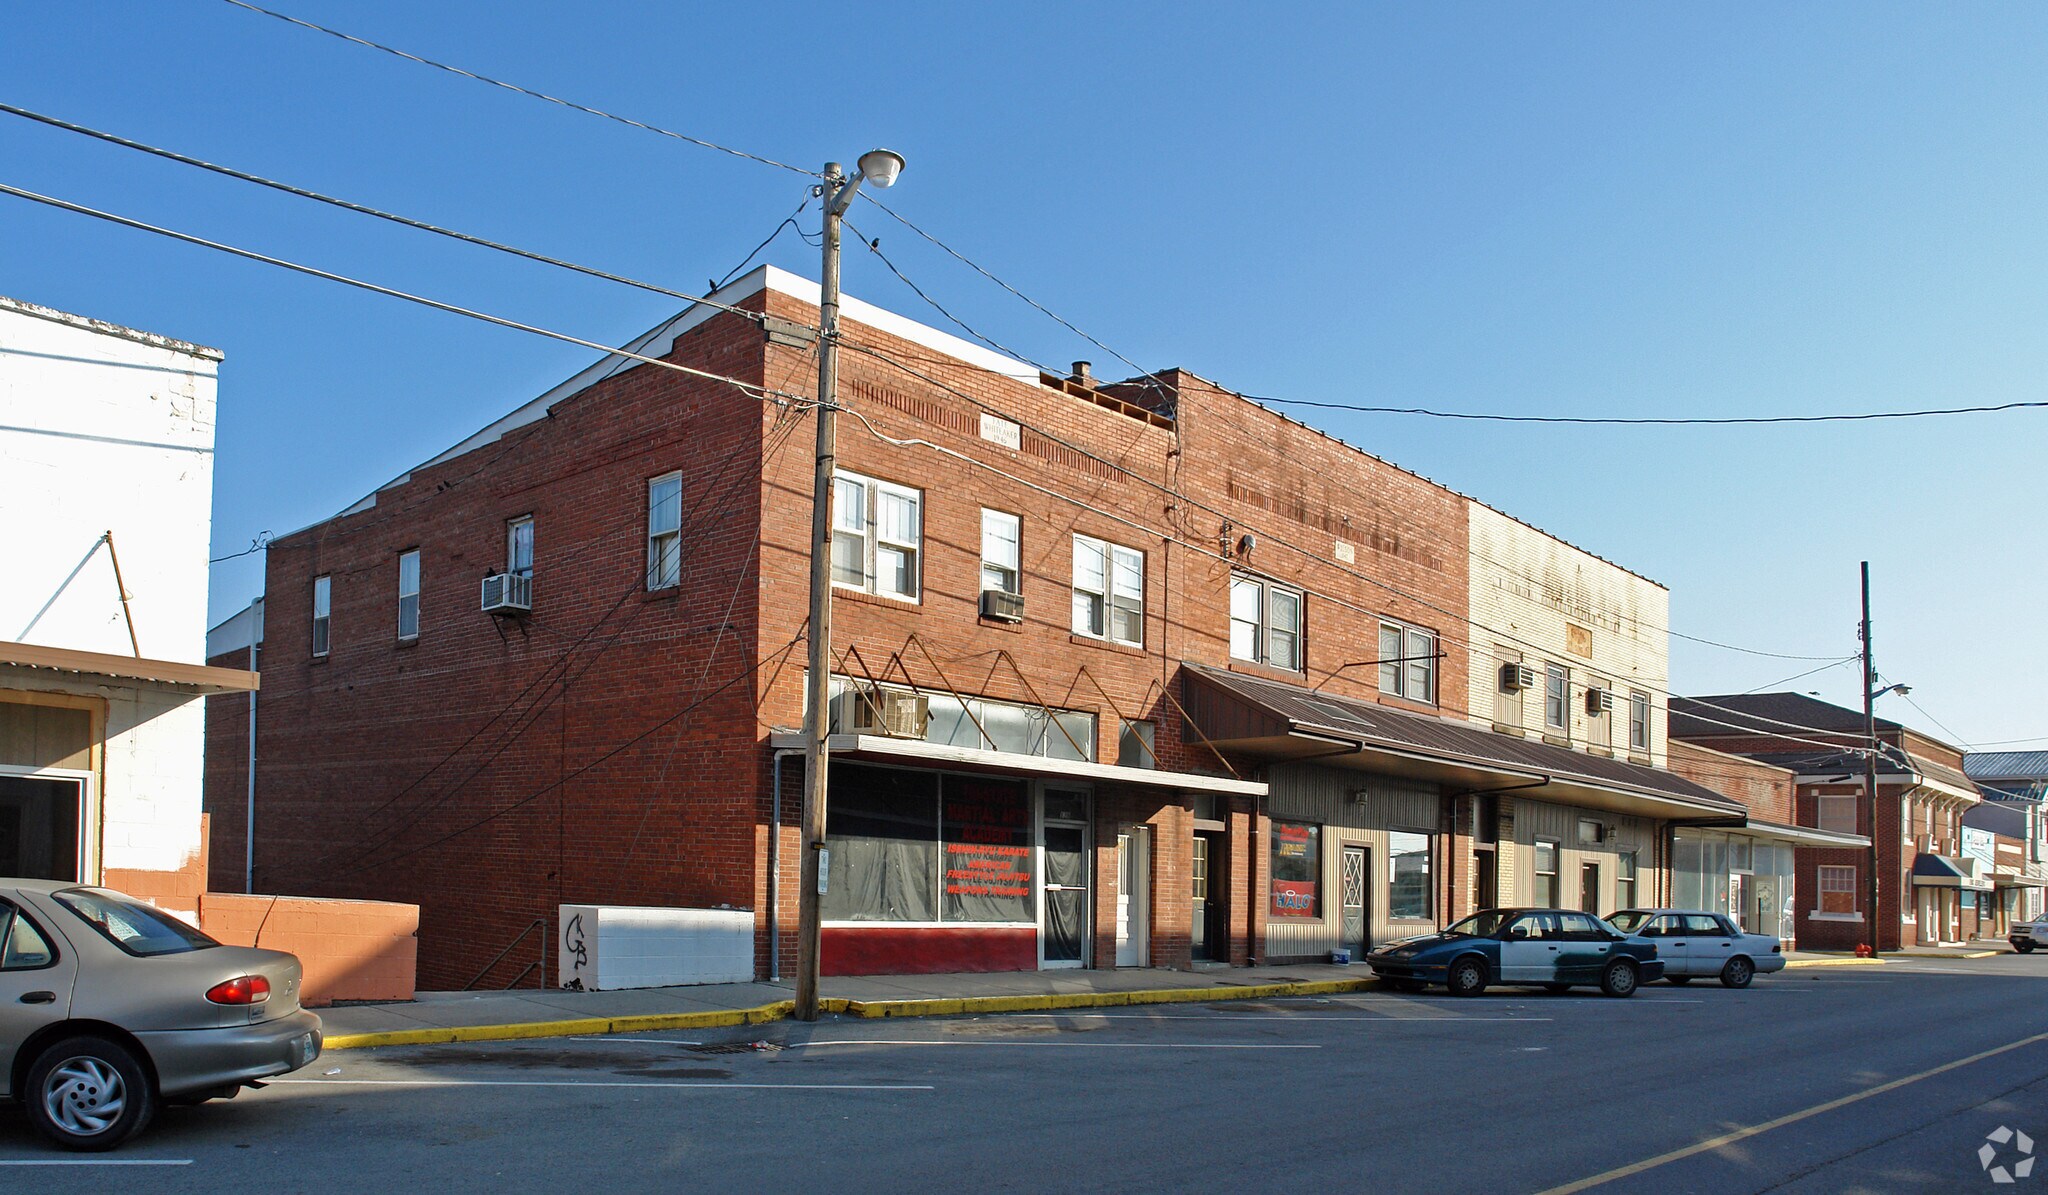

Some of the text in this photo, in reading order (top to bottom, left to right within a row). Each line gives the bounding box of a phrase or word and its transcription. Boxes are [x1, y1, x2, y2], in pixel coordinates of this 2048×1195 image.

[946, 804, 1029, 825] MARTIAL ARTS
[962, 824, 1012, 843] ACADEMY
[997, 847, 1029, 858] KARATE
[968, 860, 1011, 870] AMERICAN
[946, 870, 995, 880] FREESTYLE
[947, 884, 1029, 896] WEAPONS TRAINING
[1276, 892, 1311, 909] HALO
